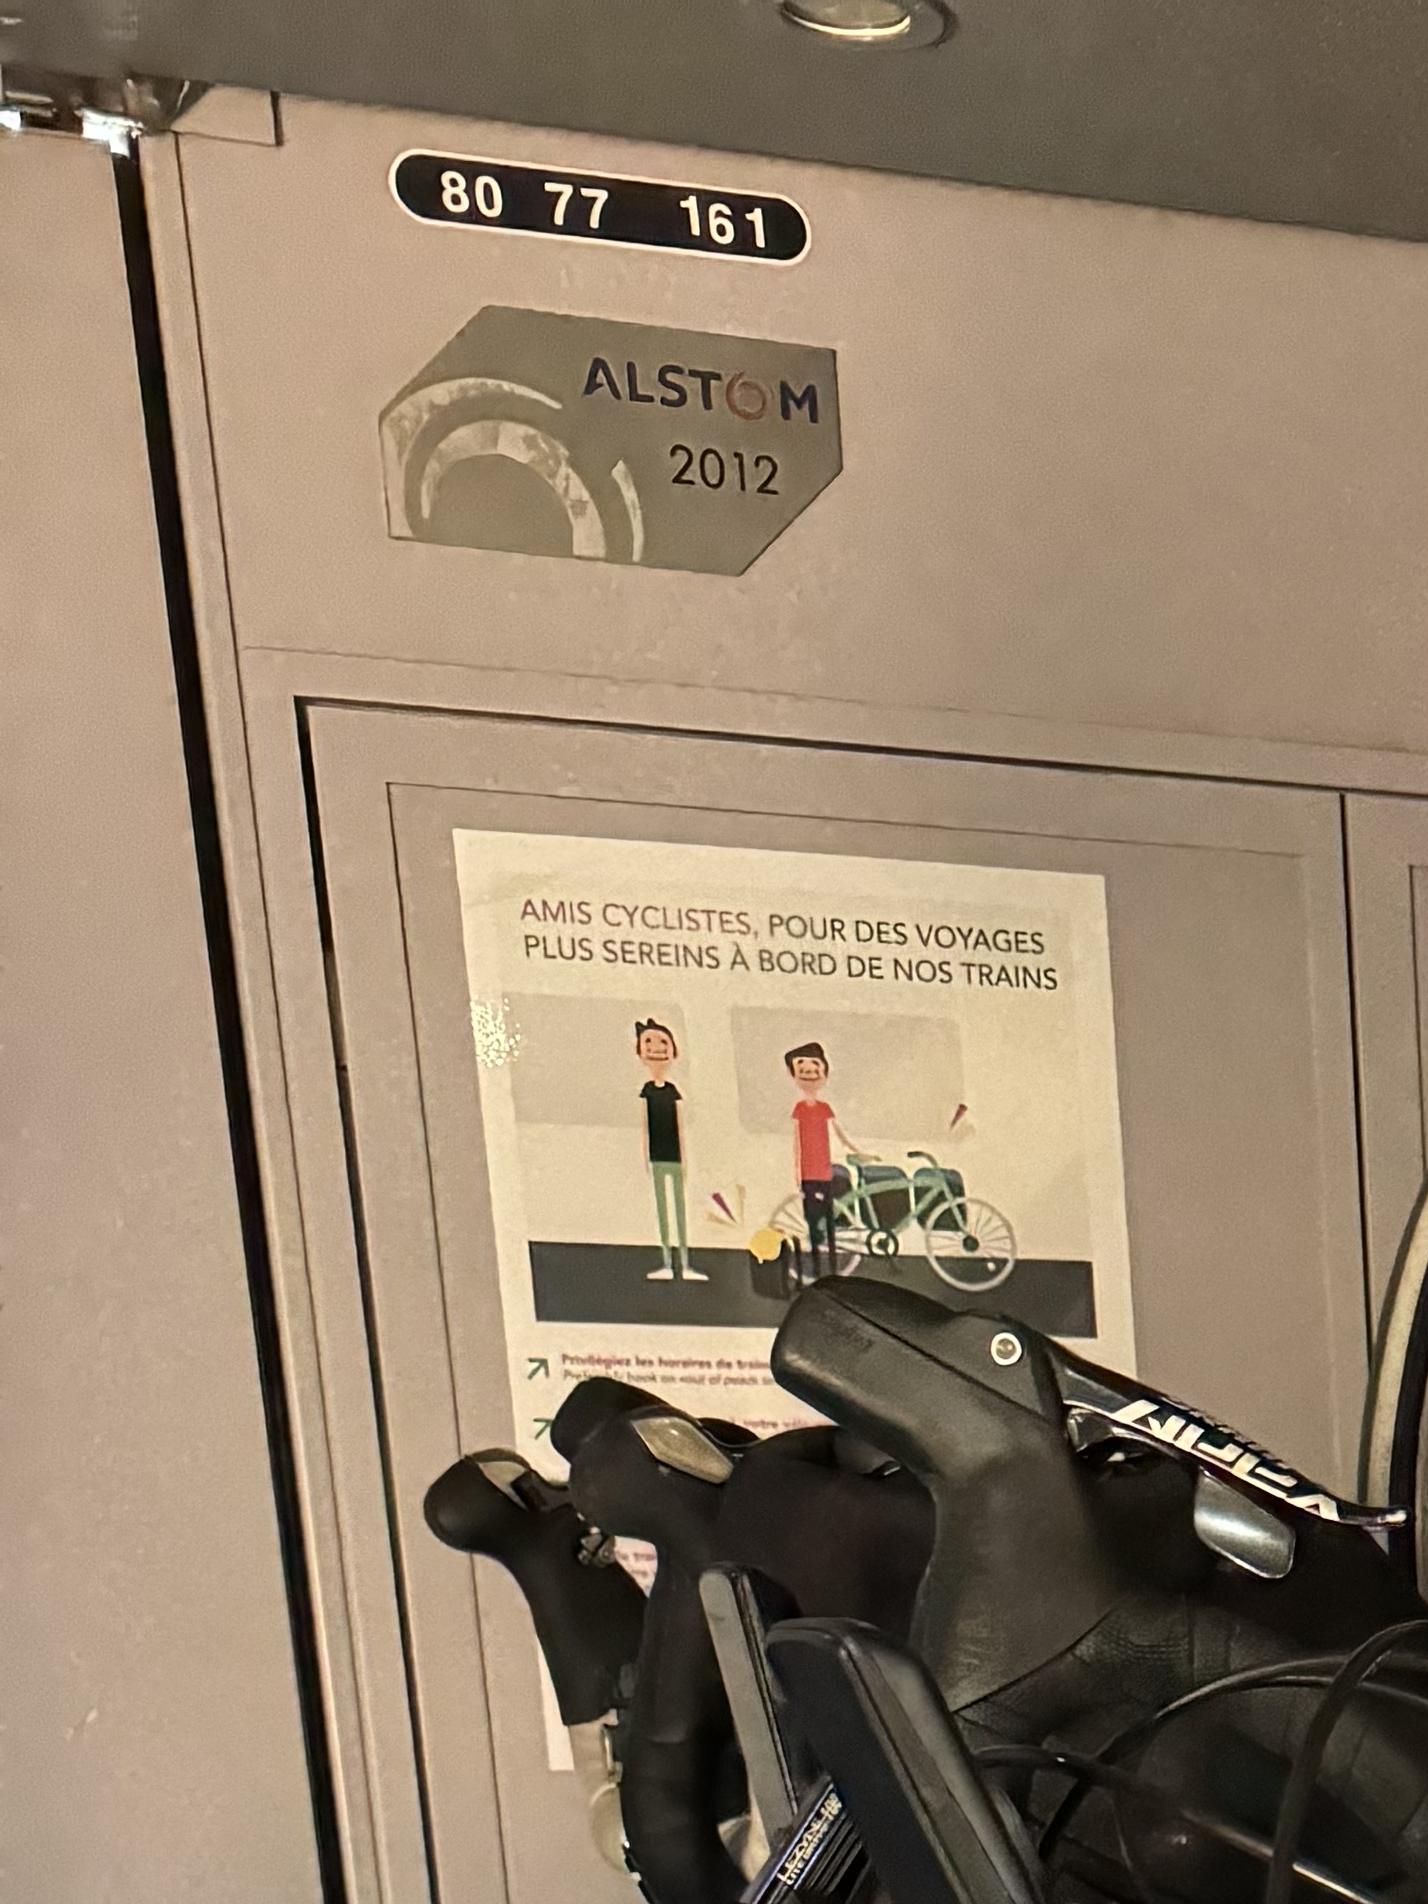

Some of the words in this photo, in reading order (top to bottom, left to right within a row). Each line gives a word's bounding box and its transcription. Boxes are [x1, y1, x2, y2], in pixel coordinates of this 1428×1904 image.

[441, 170, 503, 218] 80
[545, 181, 609, 230] 77
[680, 195, 766, 249] 161
[583, 356, 819, 424] ALSTOM
[669, 443, 780, 495] 2012
[520, 898, 593, 928] AMIS
[601, 903, 761, 939] CYCLISTES,
[767, 914, 846, 944] POUR
[855, 919, 907, 948] DES
[915, 923, 1044, 956] VOYAGES
[524, 934, 594, 963] PLUS
[602, 939, 722, 971] SEREINS
[729, 940, 751, 972] À
[759, 949, 836, 977] BORD
[846, 954, 884, 981] DE
[892, 957, 953, 985] NOS
[960, 961, 1058, 991] TRAINS
[635, 1354, 654, 1367] les
[716, 1356, 733, 1369] de
[737, 1357, 770, 1369] train
